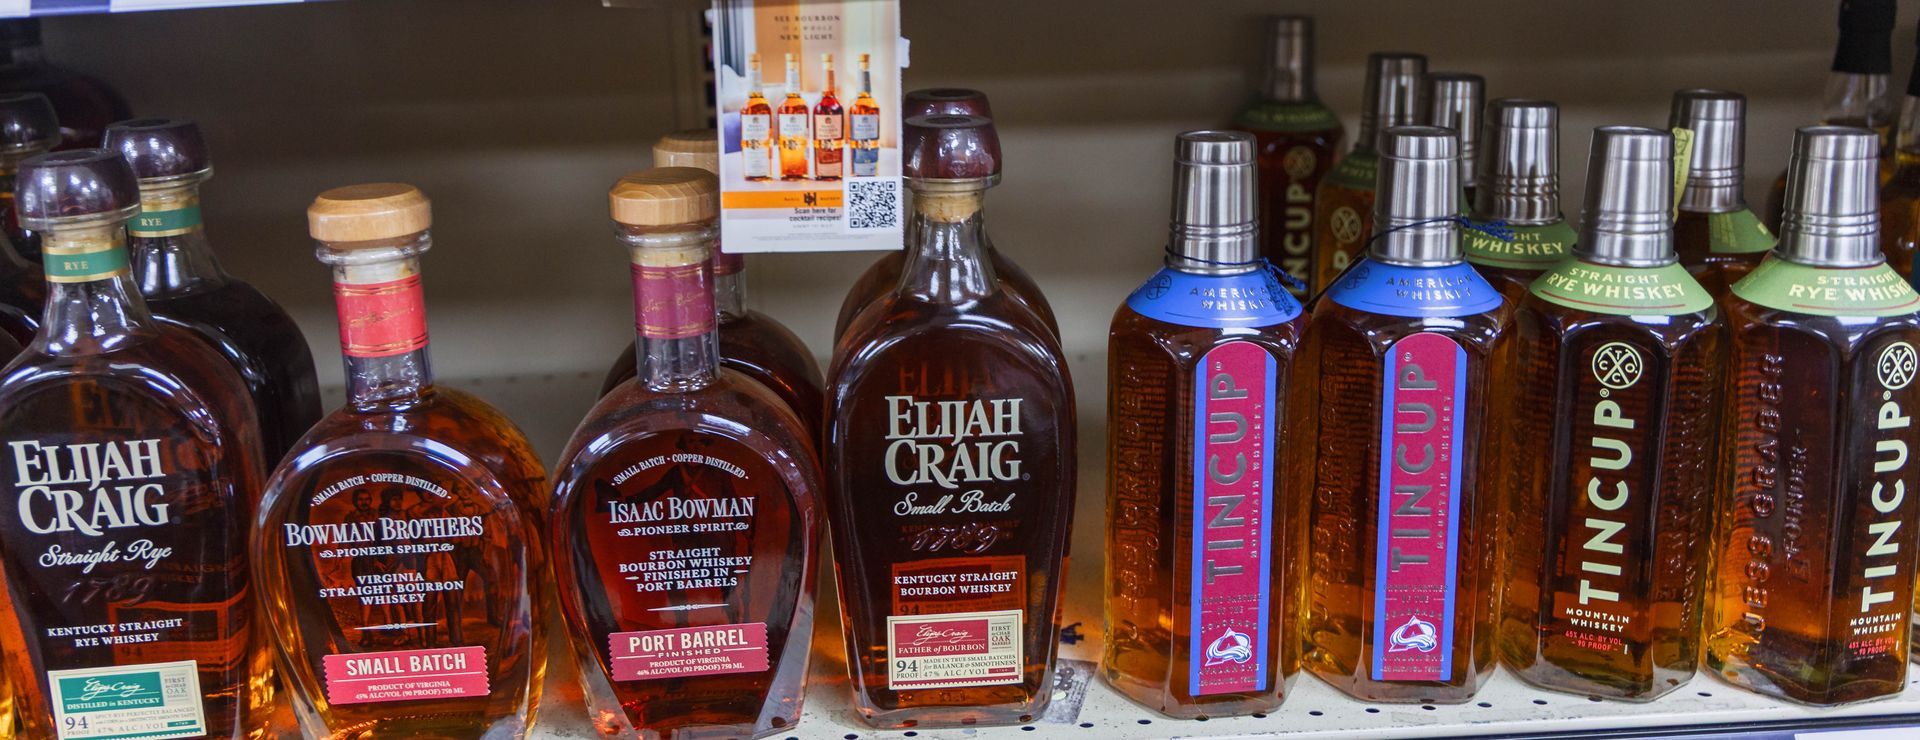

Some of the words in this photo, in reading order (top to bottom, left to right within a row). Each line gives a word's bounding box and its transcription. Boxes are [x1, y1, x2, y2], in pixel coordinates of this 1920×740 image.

[141, 218, 162, 226] RYE
[1472, 237, 1564, 255] WHISKEY
[64, 261, 88, 270] RYE
[1570, 268, 1659, 284] STRAIGHT
[1818, 270, 1896, 286] STRAIGHT
[1547, 273, 1578, 292] RYE
[1584, 282, 1686, 300] WHISKEY
[1788, 284, 1839, 300] RYE
[884, 396, 1024, 446] ELIJAH
[1752, 353, 1784, 518] GRABER
[8, 438, 166, 490] ELIJAH
[613, 464, 640, 485] SMALL
[638, 456, 666, 470] BATCH
[672, 454, 704, 464] COPPER
[704, 456, 746, 478] DISTILLED
[312, 485, 340, 506] SMALL
[338, 475, 366, 490] BATCH
[370, 473, 404, 484] COPPER
[405, 475, 448, 498] DISTILLED
[894, 491, 954, 516] Small
[952, 489, 1016, 514] Batch
[1784, 446, 1808, 555] FOUNDER
[608, 500, 664, 524] ISAAC
[667, 496, 755, 521] BOWMAN
[284, 521, 376, 547] BOWMAN
[379, 516, 484, 541] BROTHERS
[634, 524, 690, 536] PIONEER
[692, 522, 735, 532] SPIRIT
[39, 540, 120, 574] Straight
[124, 539, 172, 570] Rye
[336, 546, 394, 558] PIONEER
[397, 544, 439, 554] SPIRIT
[649, 548, 721, 560] STRAIGHT
[619, 560, 688, 573] BOURBON
[689, 556, 752, 568] WHISKEY
[356, 572, 424, 584] VIRGINIA
[644, 569, 710, 581] FINISHED
[714, 568, 730, 577] IN
[894, 574, 957, 585] KENTUCKY
[960, 571, 1018, 582] STRAIGHT
[320, 584, 394, 598] STRAIGHT
[396, 581, 464, 593] BOURBON
[636, 582, 672, 593] PORT
[676, 578, 738, 590] BARRELS
[900, 586, 956, 596] BOURBON
[960, 583, 1012, 594] WHISKEY
[361, 593, 426, 606] WHISKEY
[1566, 608, 1630, 624] MOUNTAIN
[1850, 612, 1902, 626] MOUNTAIN
[47, 623, 116, 638] KENTUCKY
[119, 618, 184, 632] STRAIGHT
[1570, 618, 1624, 632] WHISKEY
[1854, 622, 1896, 636] WHISKEY
[75, 636, 100, 648] RYE
[102, 632, 160, 646] WHISKEY
[629, 634, 676, 652] PORT
[681, 628, 748, 650] BARREL
[1565, 630, 1578, 638] 45%
[658, 648, 721, 658] FINISHED
[898, 646, 932, 654] FATHER
[934, 646, 942, 654] of
[943, 643, 985, 652] BOURBON
[1588, 641, 1612, 651] PROOF
[1868, 645, 1886, 654] PROOF
[346, 658, 404, 676] SMALL
[410, 652, 466, 672] BATCH
[650, 658, 686, 668] PRODUCT
[686, 658, 696, 666] OF
[696, 656, 730, 665] VIRGINIA
[896, 660, 918, 672] 94
[650, 666, 682, 675] ALC/VOL
[683, 666, 692, 674] (92
[694, 664, 721, 672] PROOF)
[368, 682, 404, 692] PRODUCT
[416, 680, 450, 689] VIRGINIA
[356, 692, 369, 700] 45%
[370, 690, 402, 698] ALC/VOL
[402, 690, 412, 698] (90
[414, 688, 441, 696] PROOF)
[66, 701, 108, 710] DISTILLED
[118, 698, 160, 706] KENTUCKY
[65, 716, 89, 730] 94
